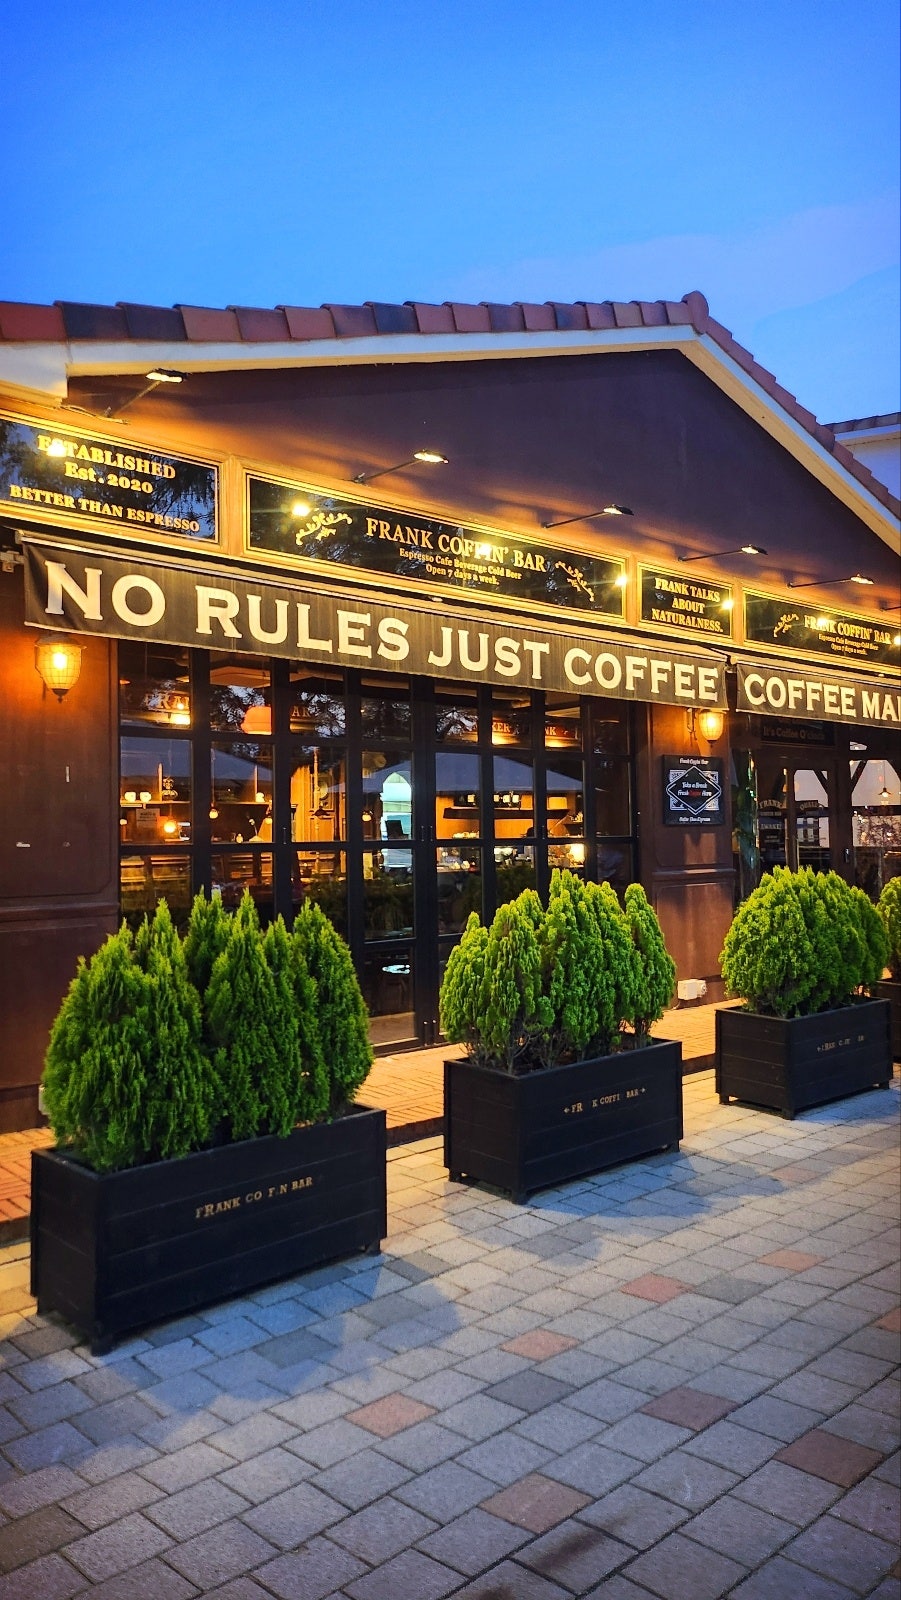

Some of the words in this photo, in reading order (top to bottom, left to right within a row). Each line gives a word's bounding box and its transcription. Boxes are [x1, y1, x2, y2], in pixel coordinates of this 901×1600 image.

[107, 474, 153, 494] 2020
[10, 484, 76, 509] BETTER
[78, 498, 123, 517] THAN
[127, 508, 200, 532] ESPRESSO
[365, 517, 433, 549] FRANK
[513, 549, 546, 572] BAR
[399, 547, 434, 563] Espresso
[435, 555, 452, 566] Cafe
[426, 563, 446, 576] Open
[448, 569, 453, 578] 7
[454, 569, 472, 581] days
[654, 578, 689, 596] FRANK
[690, 585, 721, 602] TALKS
[672, 597, 705, 614] ABOUT
[45, 560, 166, 627] NO
[196, 585, 410, 661] RULES
[427, 627, 550, 680] JUST
[564, 648, 719, 702] COFFEE
[651, 608, 723, 633] NATURALNESS.
[874, 630, 892, 644] BAR
[744, 673, 857, 717] COFFEE
[195, 1197, 241, 1218] FRANK
[292, 1176, 313, 1190] BAR
